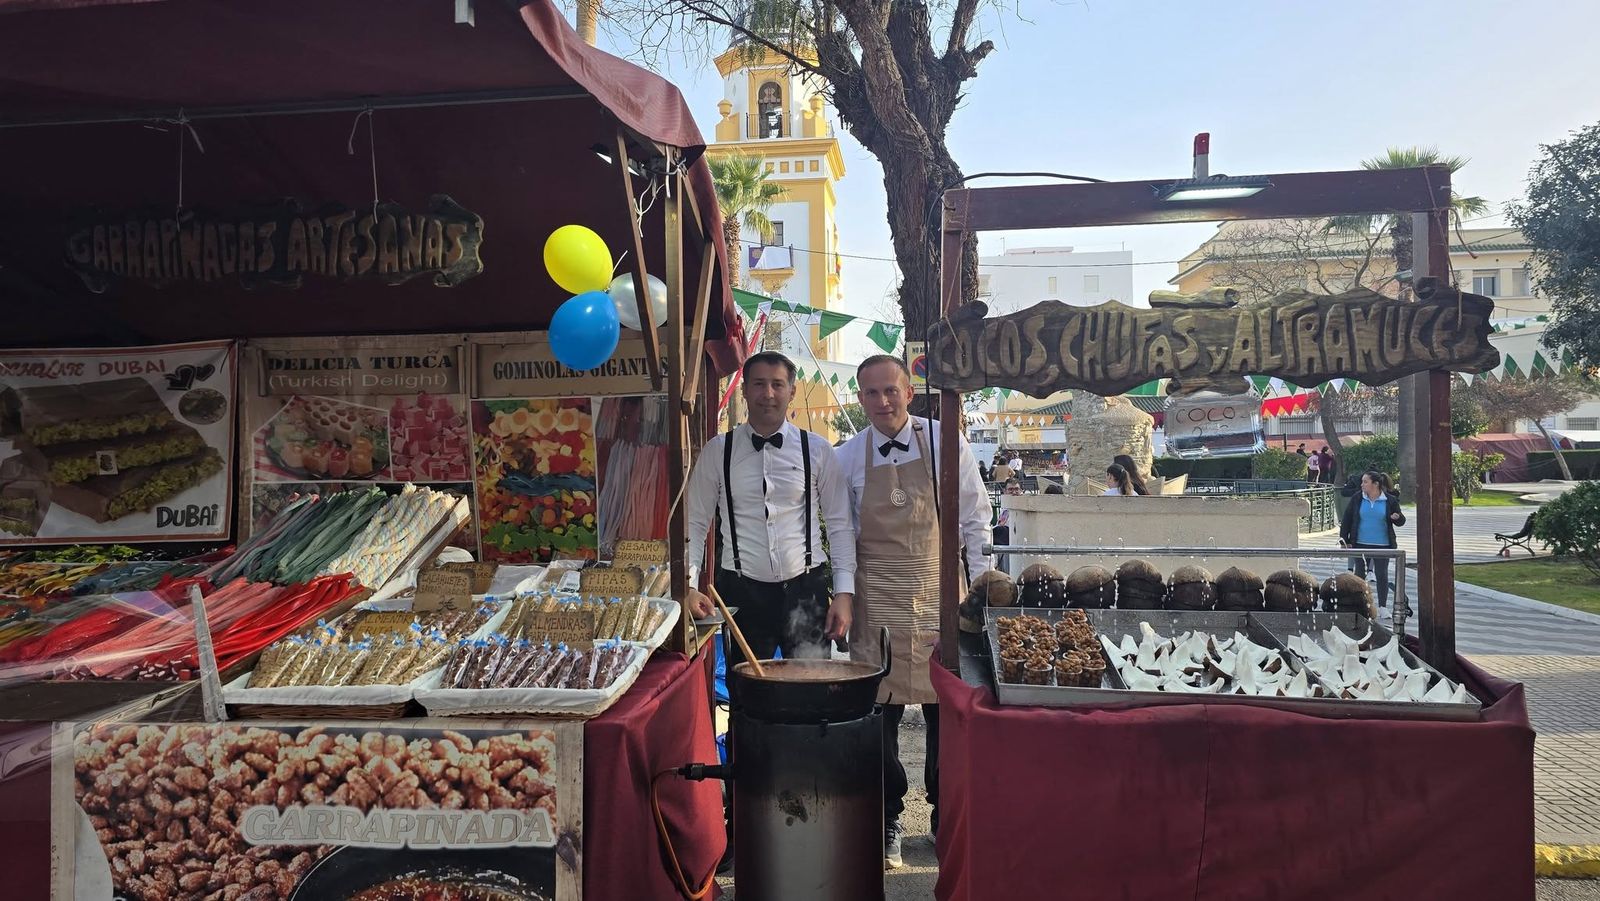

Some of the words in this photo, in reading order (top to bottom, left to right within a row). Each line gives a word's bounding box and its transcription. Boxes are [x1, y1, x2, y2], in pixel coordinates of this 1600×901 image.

[286, 210, 468, 277] ARTESANAS
[1059, 311, 1198, 383] CHUFAS
[99, 360, 166, 376] DUBAI
[268, 357, 360, 370] DELICIA
[369, 355, 451, 370] TURCA
[590, 357, 668, 377] GIGANTS
[268, 375, 351, 388] (Turkish
[361, 374, 447, 388] Delight)
[619, 542, 660, 552] SESAMO
[588, 573, 627, 585] PIPAS
[529, 615, 588, 632] ALMENDRAS
